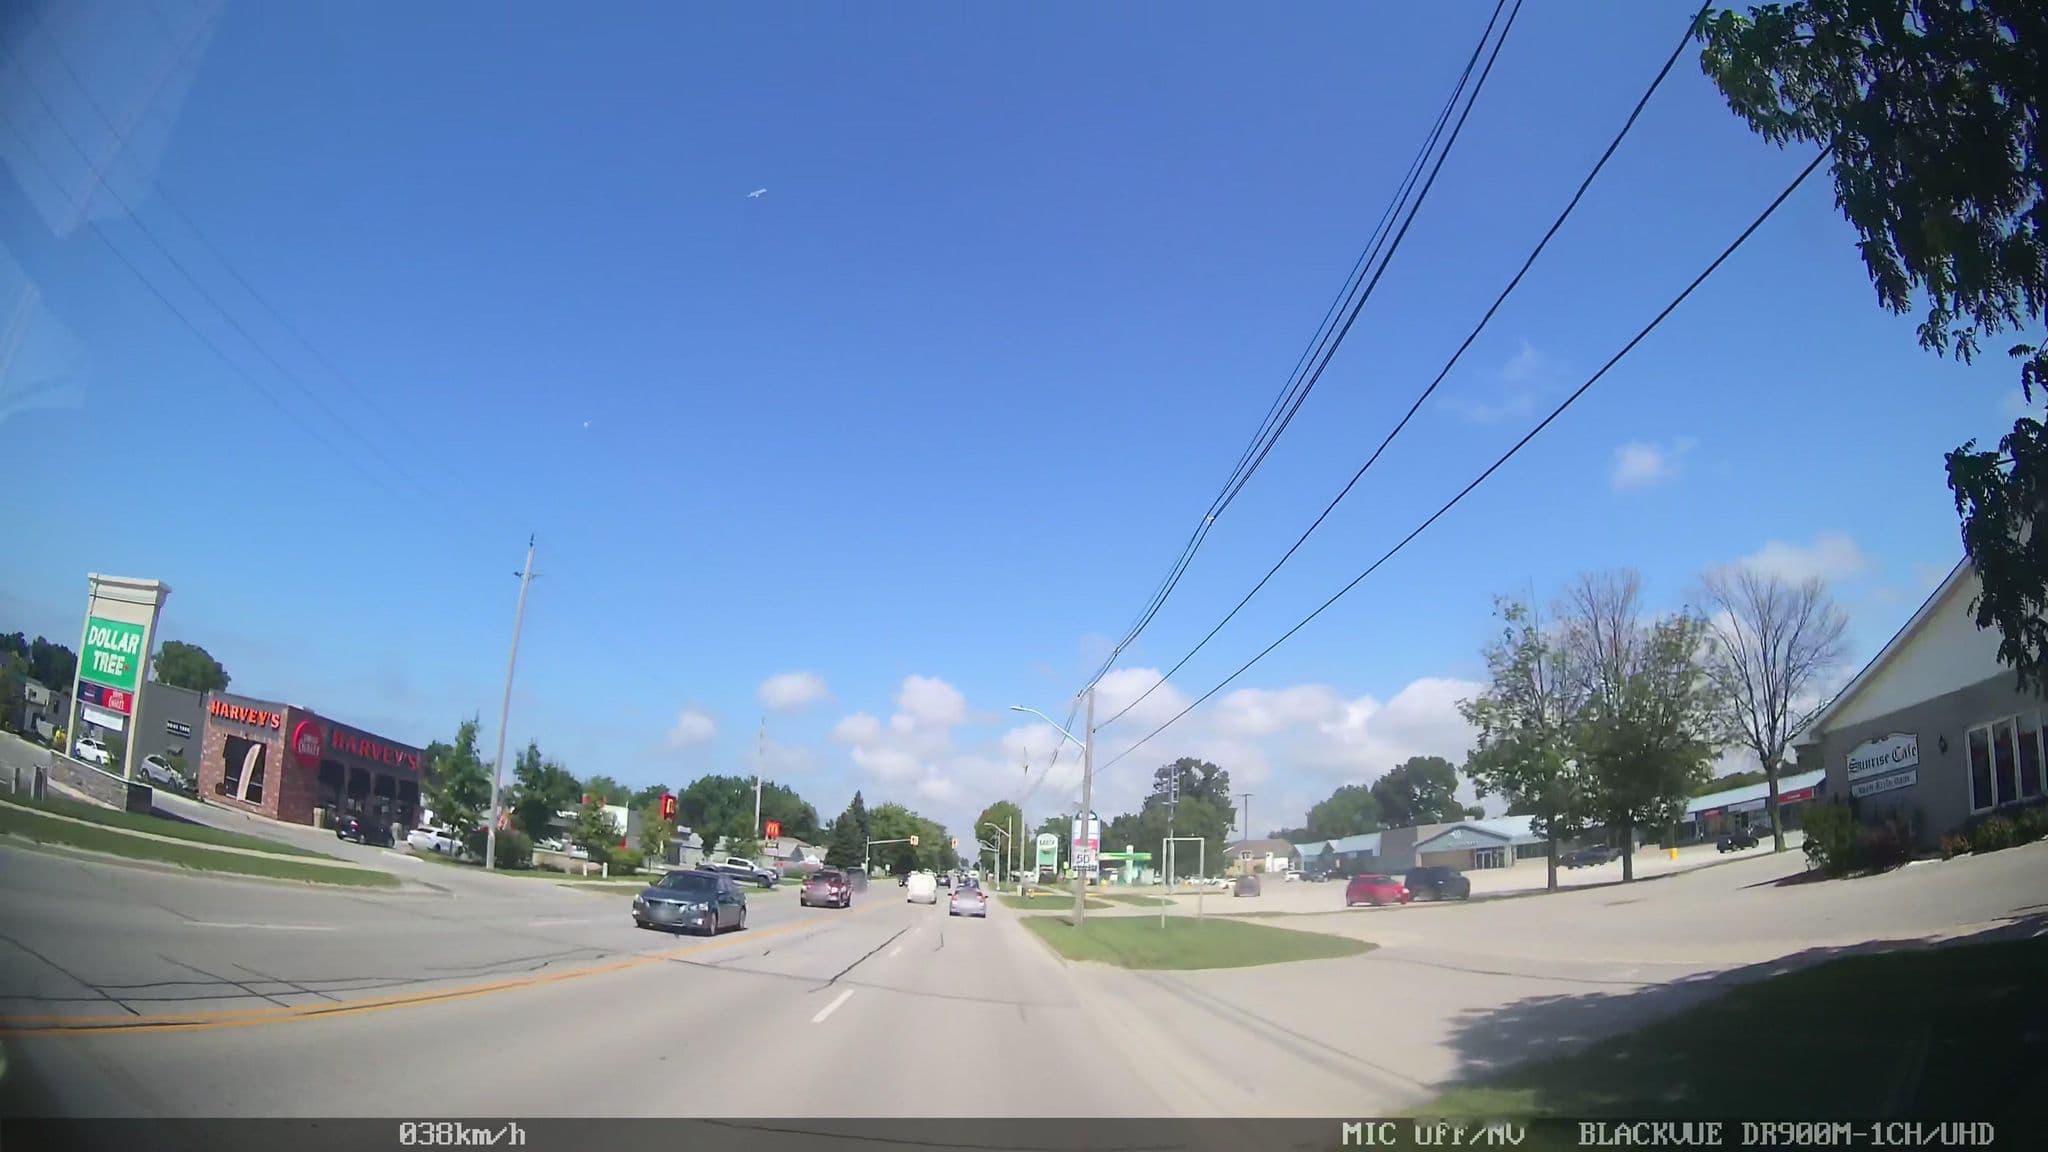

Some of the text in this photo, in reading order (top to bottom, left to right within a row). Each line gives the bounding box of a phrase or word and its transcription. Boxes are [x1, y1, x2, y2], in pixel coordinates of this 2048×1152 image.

[87, 625, 140, 655] DOLLAR
[93, 650, 125, 676] TREE
[211, 700, 281, 729] HARVEY'S
[331, 728, 418, 771] HARVEY'S
[1848, 752, 1890, 774] Sunrise
